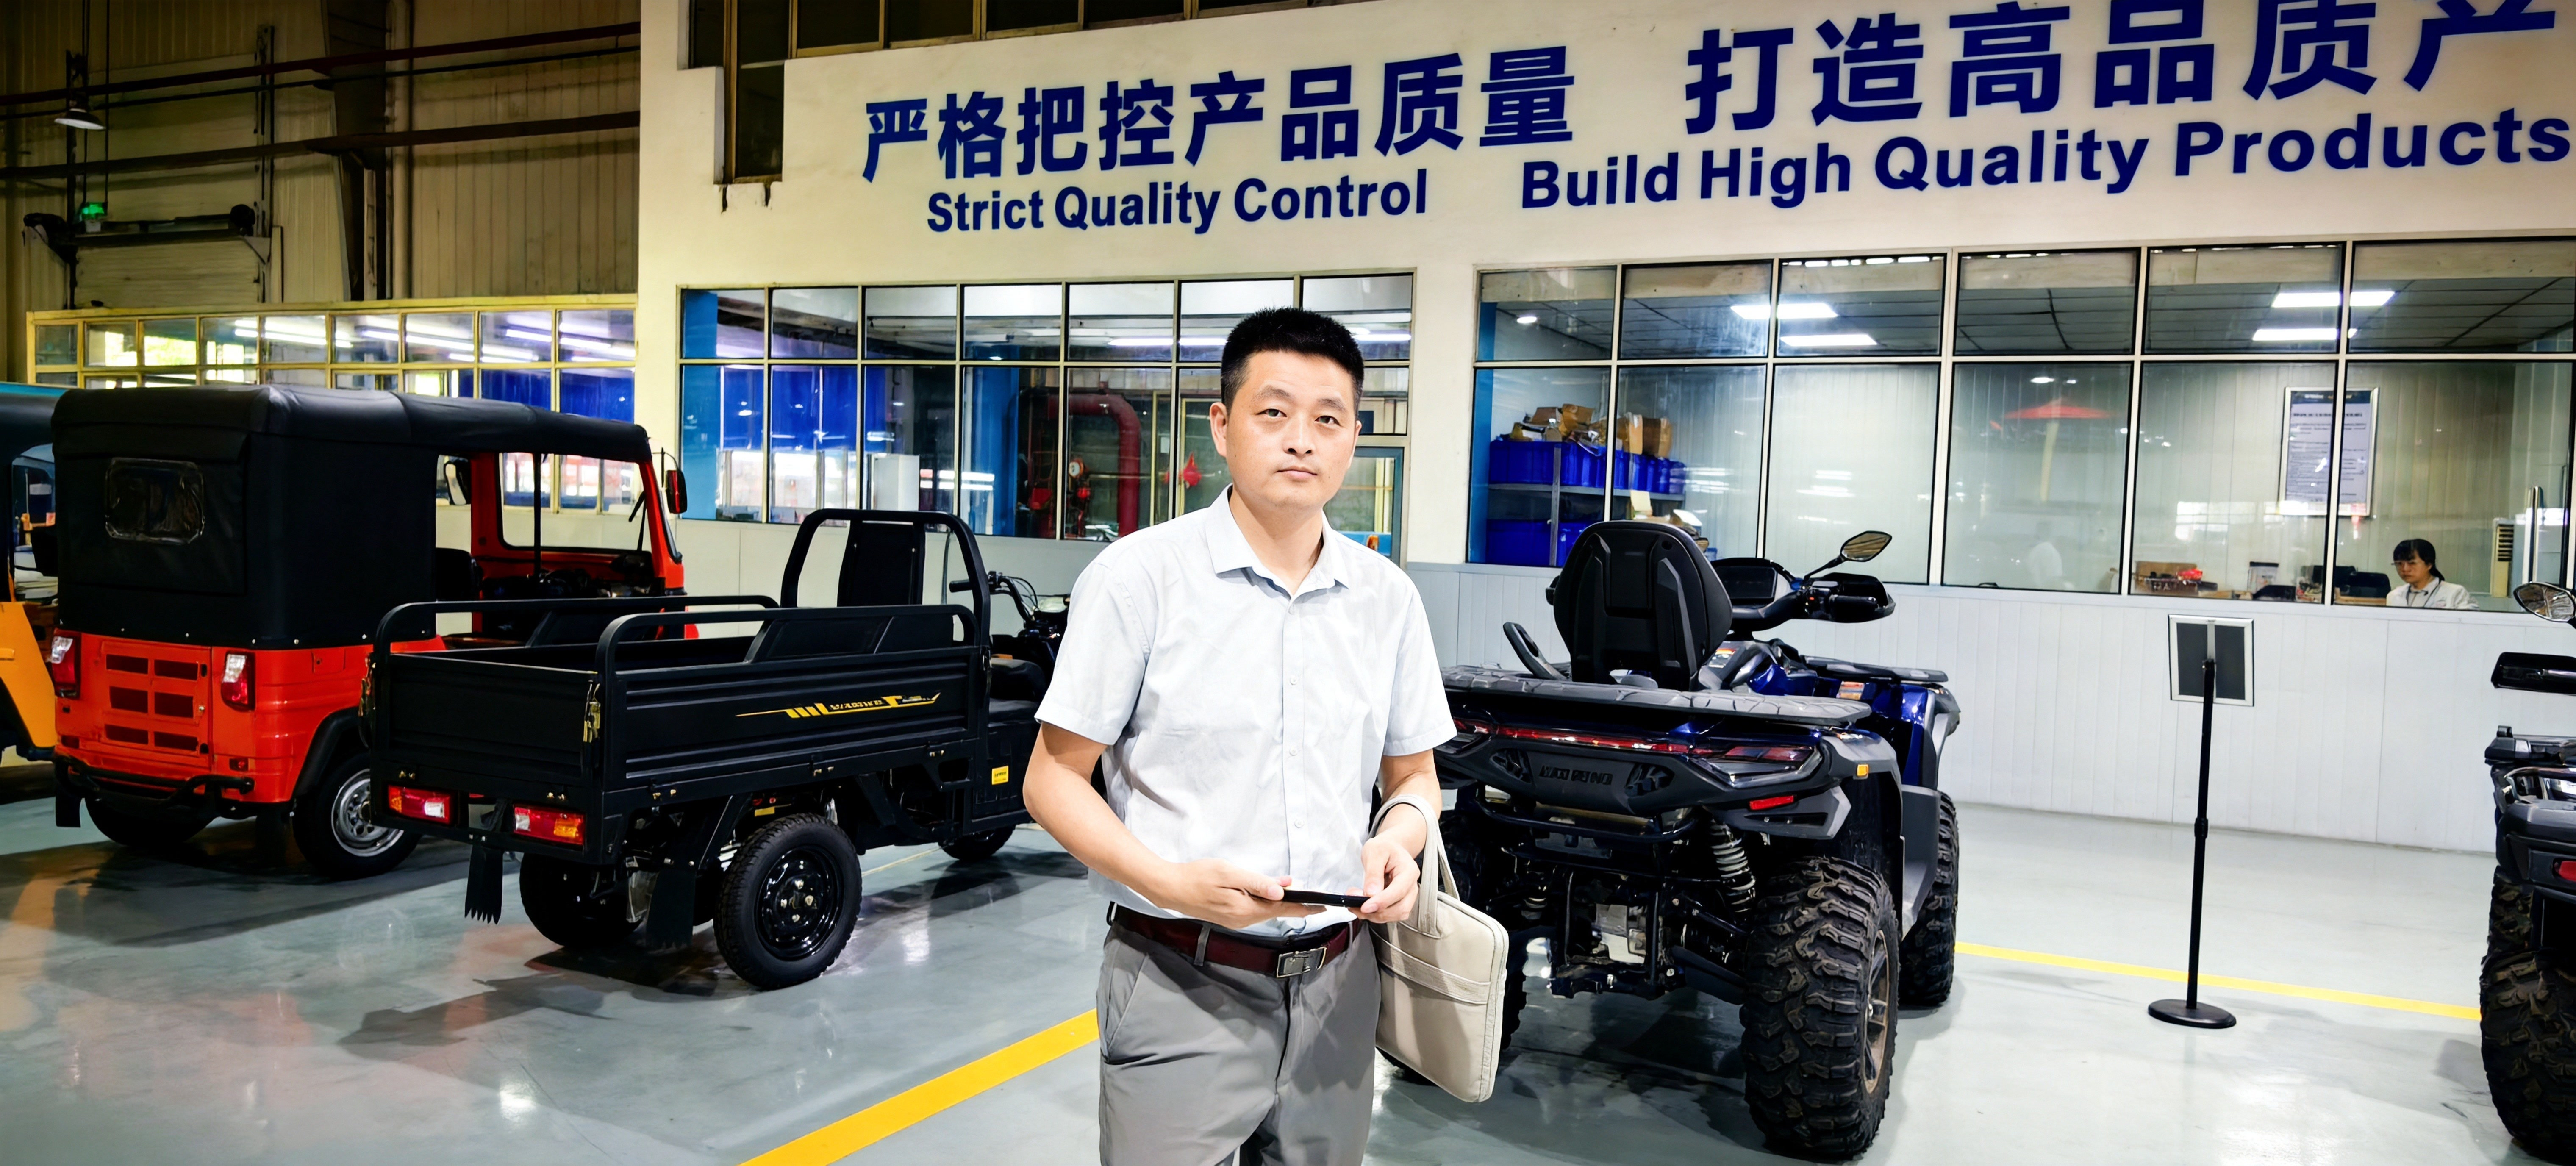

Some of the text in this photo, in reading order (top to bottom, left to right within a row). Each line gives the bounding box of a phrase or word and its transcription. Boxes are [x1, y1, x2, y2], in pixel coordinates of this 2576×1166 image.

[863, 46, 1575, 183] 严格把控产品质量
[1685, 0, 2556, 135] 打造高品质产
[928, 169, 1427, 235] Strict Quality Control
[1521, 109, 2570, 209] Build High Quality Products
